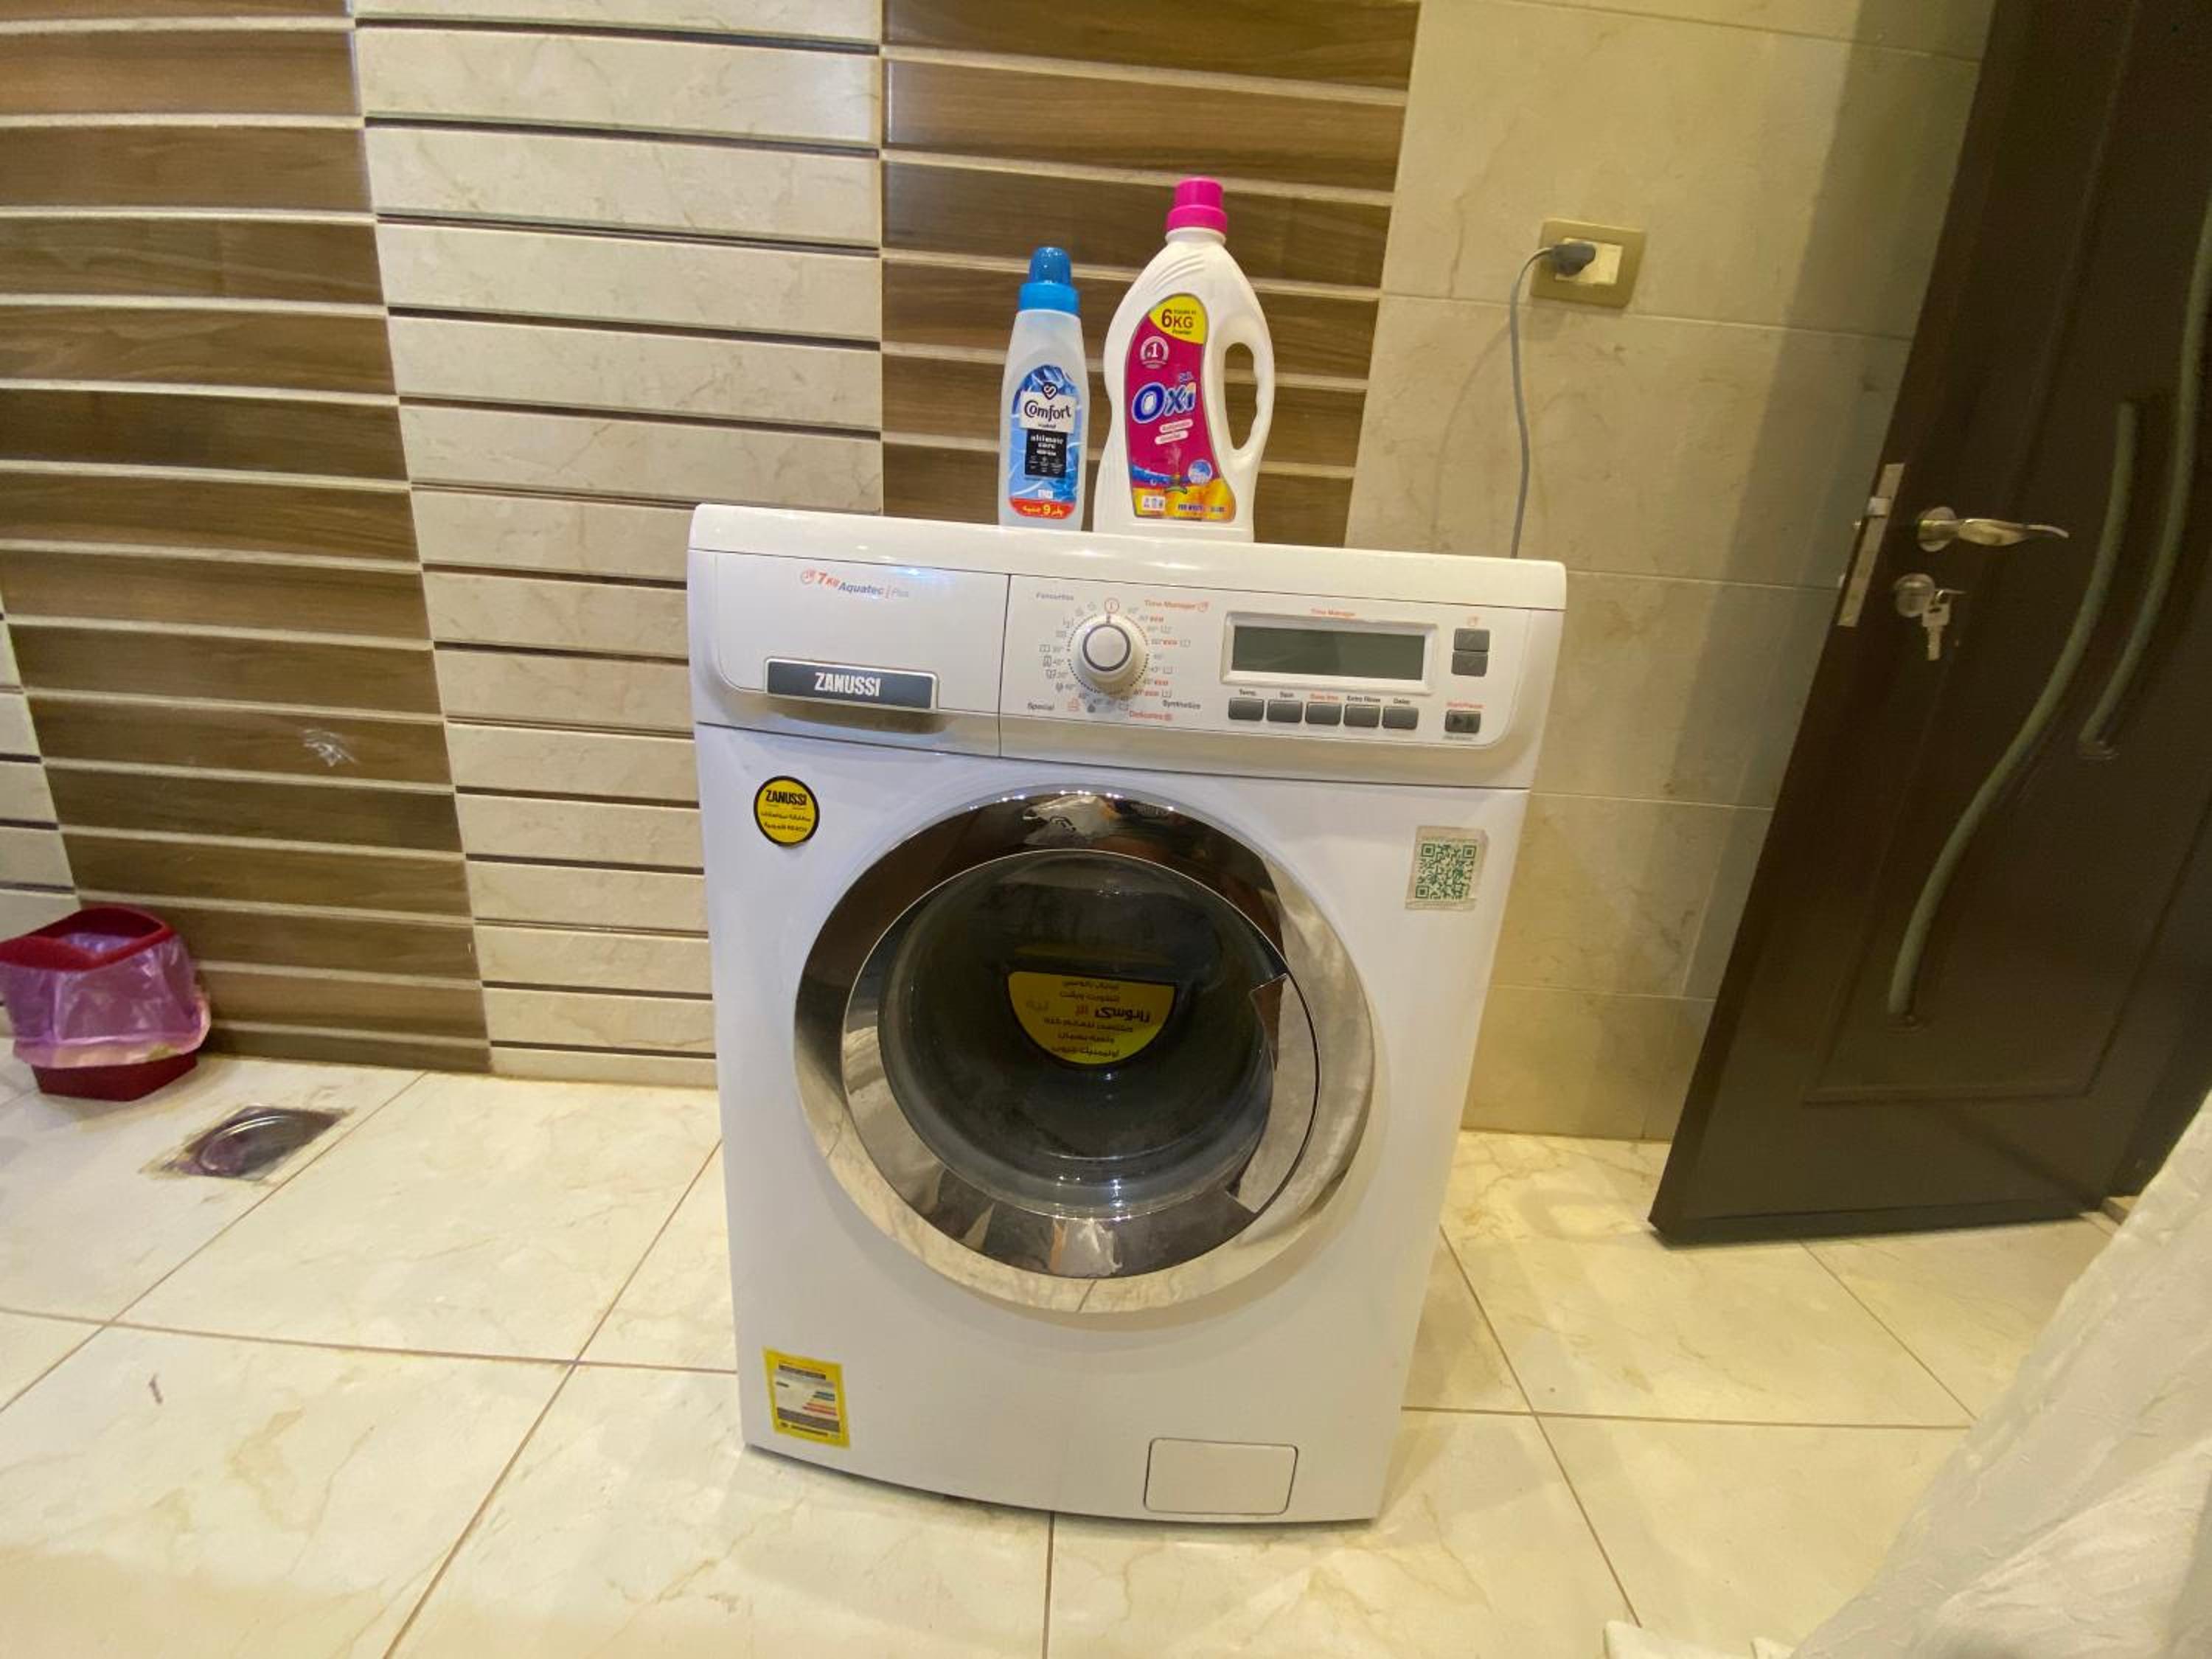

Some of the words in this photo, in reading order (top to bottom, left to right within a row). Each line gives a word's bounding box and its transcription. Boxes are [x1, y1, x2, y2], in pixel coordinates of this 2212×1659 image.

[1024, 400, 1071, 422] Comfort
[1043, 504, 1051, 515] 9
[838, 582, 884, 595] Aquatec
[814, 672, 881, 697] ZANUSSI
[765, 790, 807, 806] ZANUSSI
